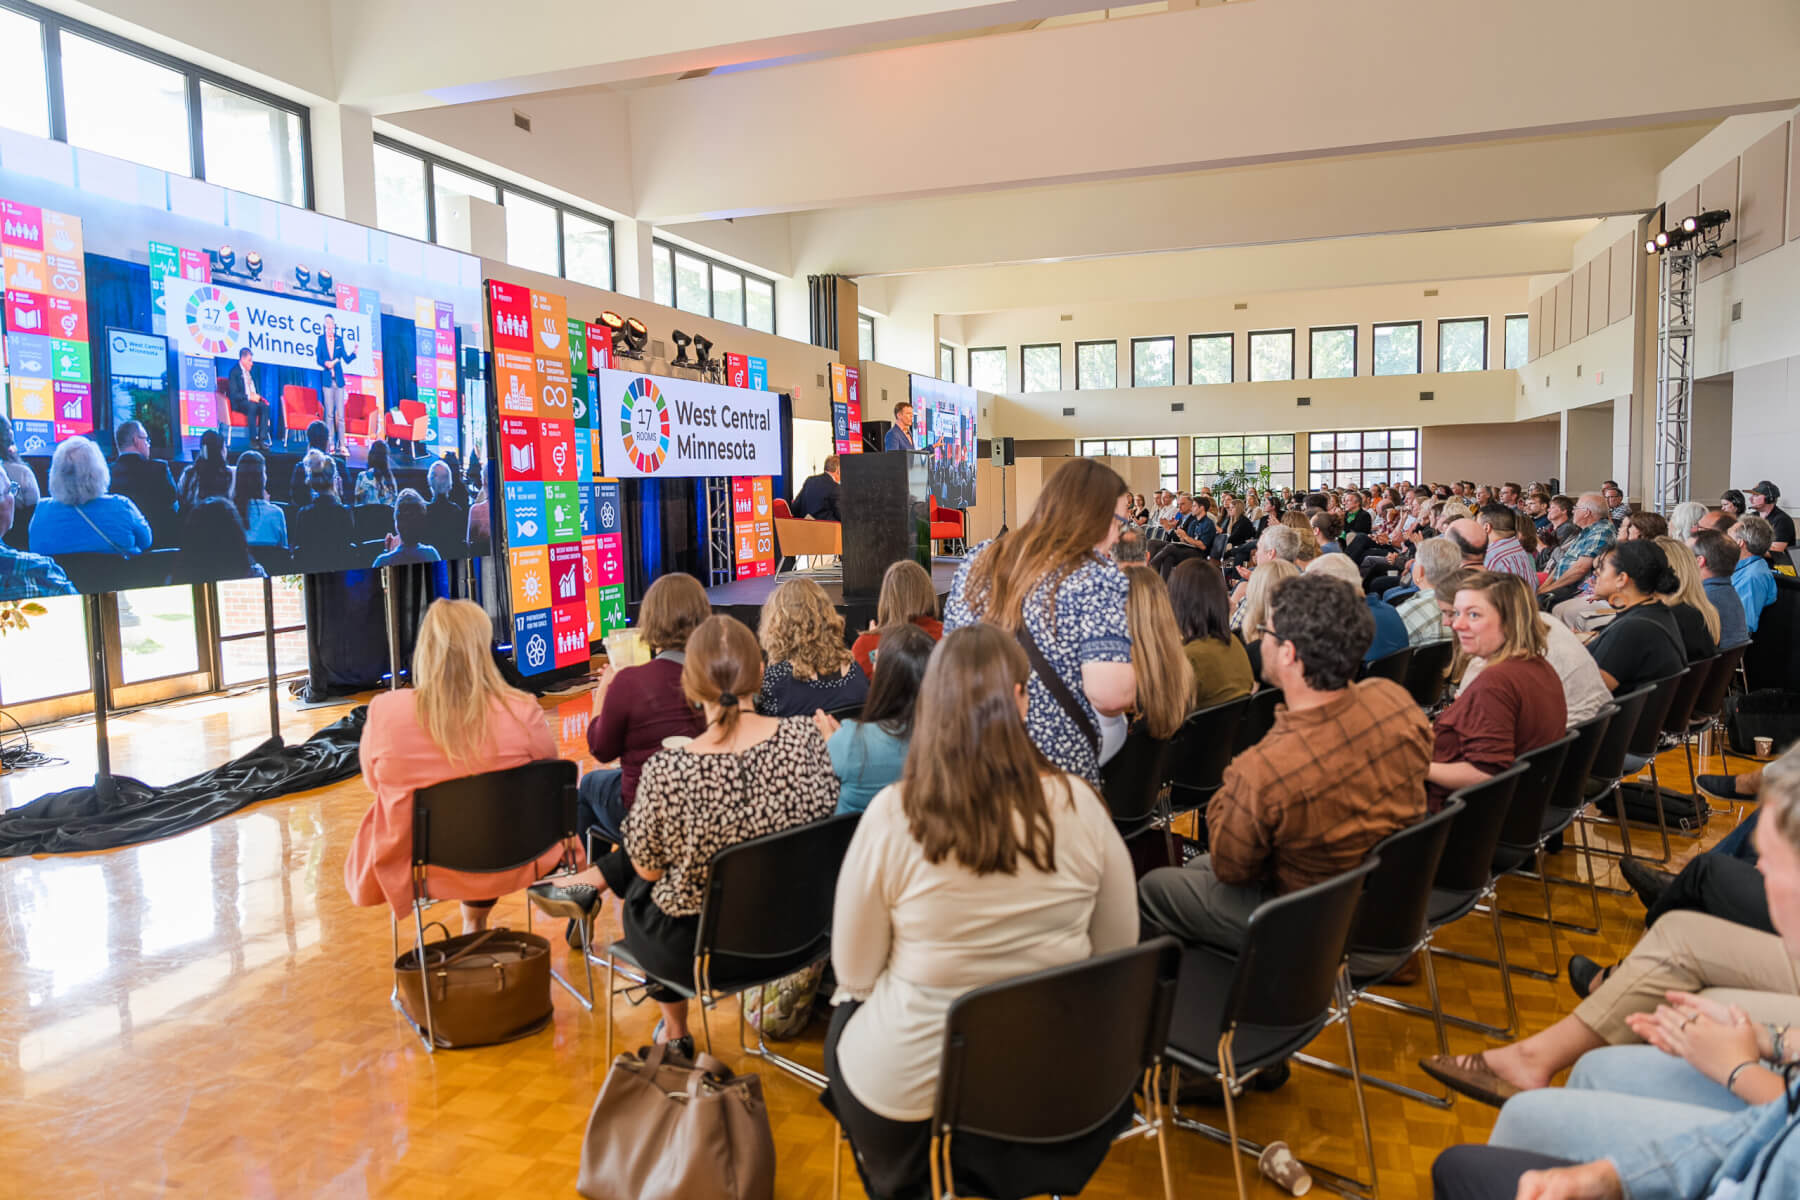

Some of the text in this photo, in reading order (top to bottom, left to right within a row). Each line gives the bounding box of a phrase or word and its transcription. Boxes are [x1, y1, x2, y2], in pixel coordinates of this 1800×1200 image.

[47, 256, 56, 266] 12
[8, 291, 14, 301] 4
[492, 285, 497, 299] 1
[532, 294, 538, 308] 2
[204, 308, 220, 324] 17
[246, 306, 295, 331] West
[497, 353, 505, 368] 11
[536, 359, 544, 373] 12
[638, 408, 652, 430] 17
[676, 400, 770, 432] West Central
[15, 421, 24, 432] 17
[503, 420, 509, 434] 4
[541, 422, 547, 436] 5
[636, 432, 657, 442] ROOMS
[677, 433, 756, 460] Minnesota
[507, 486, 516, 500] 14
[545, 486, 553, 499] 15
[594, 486, 600, 497] 17
[597, 538, 604, 550] 10
[512, 552, 518, 566] 7
[550, 548, 555, 561] 8
[600, 590, 605, 602] 3
[554, 610, 558, 623] 1
[516, 617, 524, 632] 17
